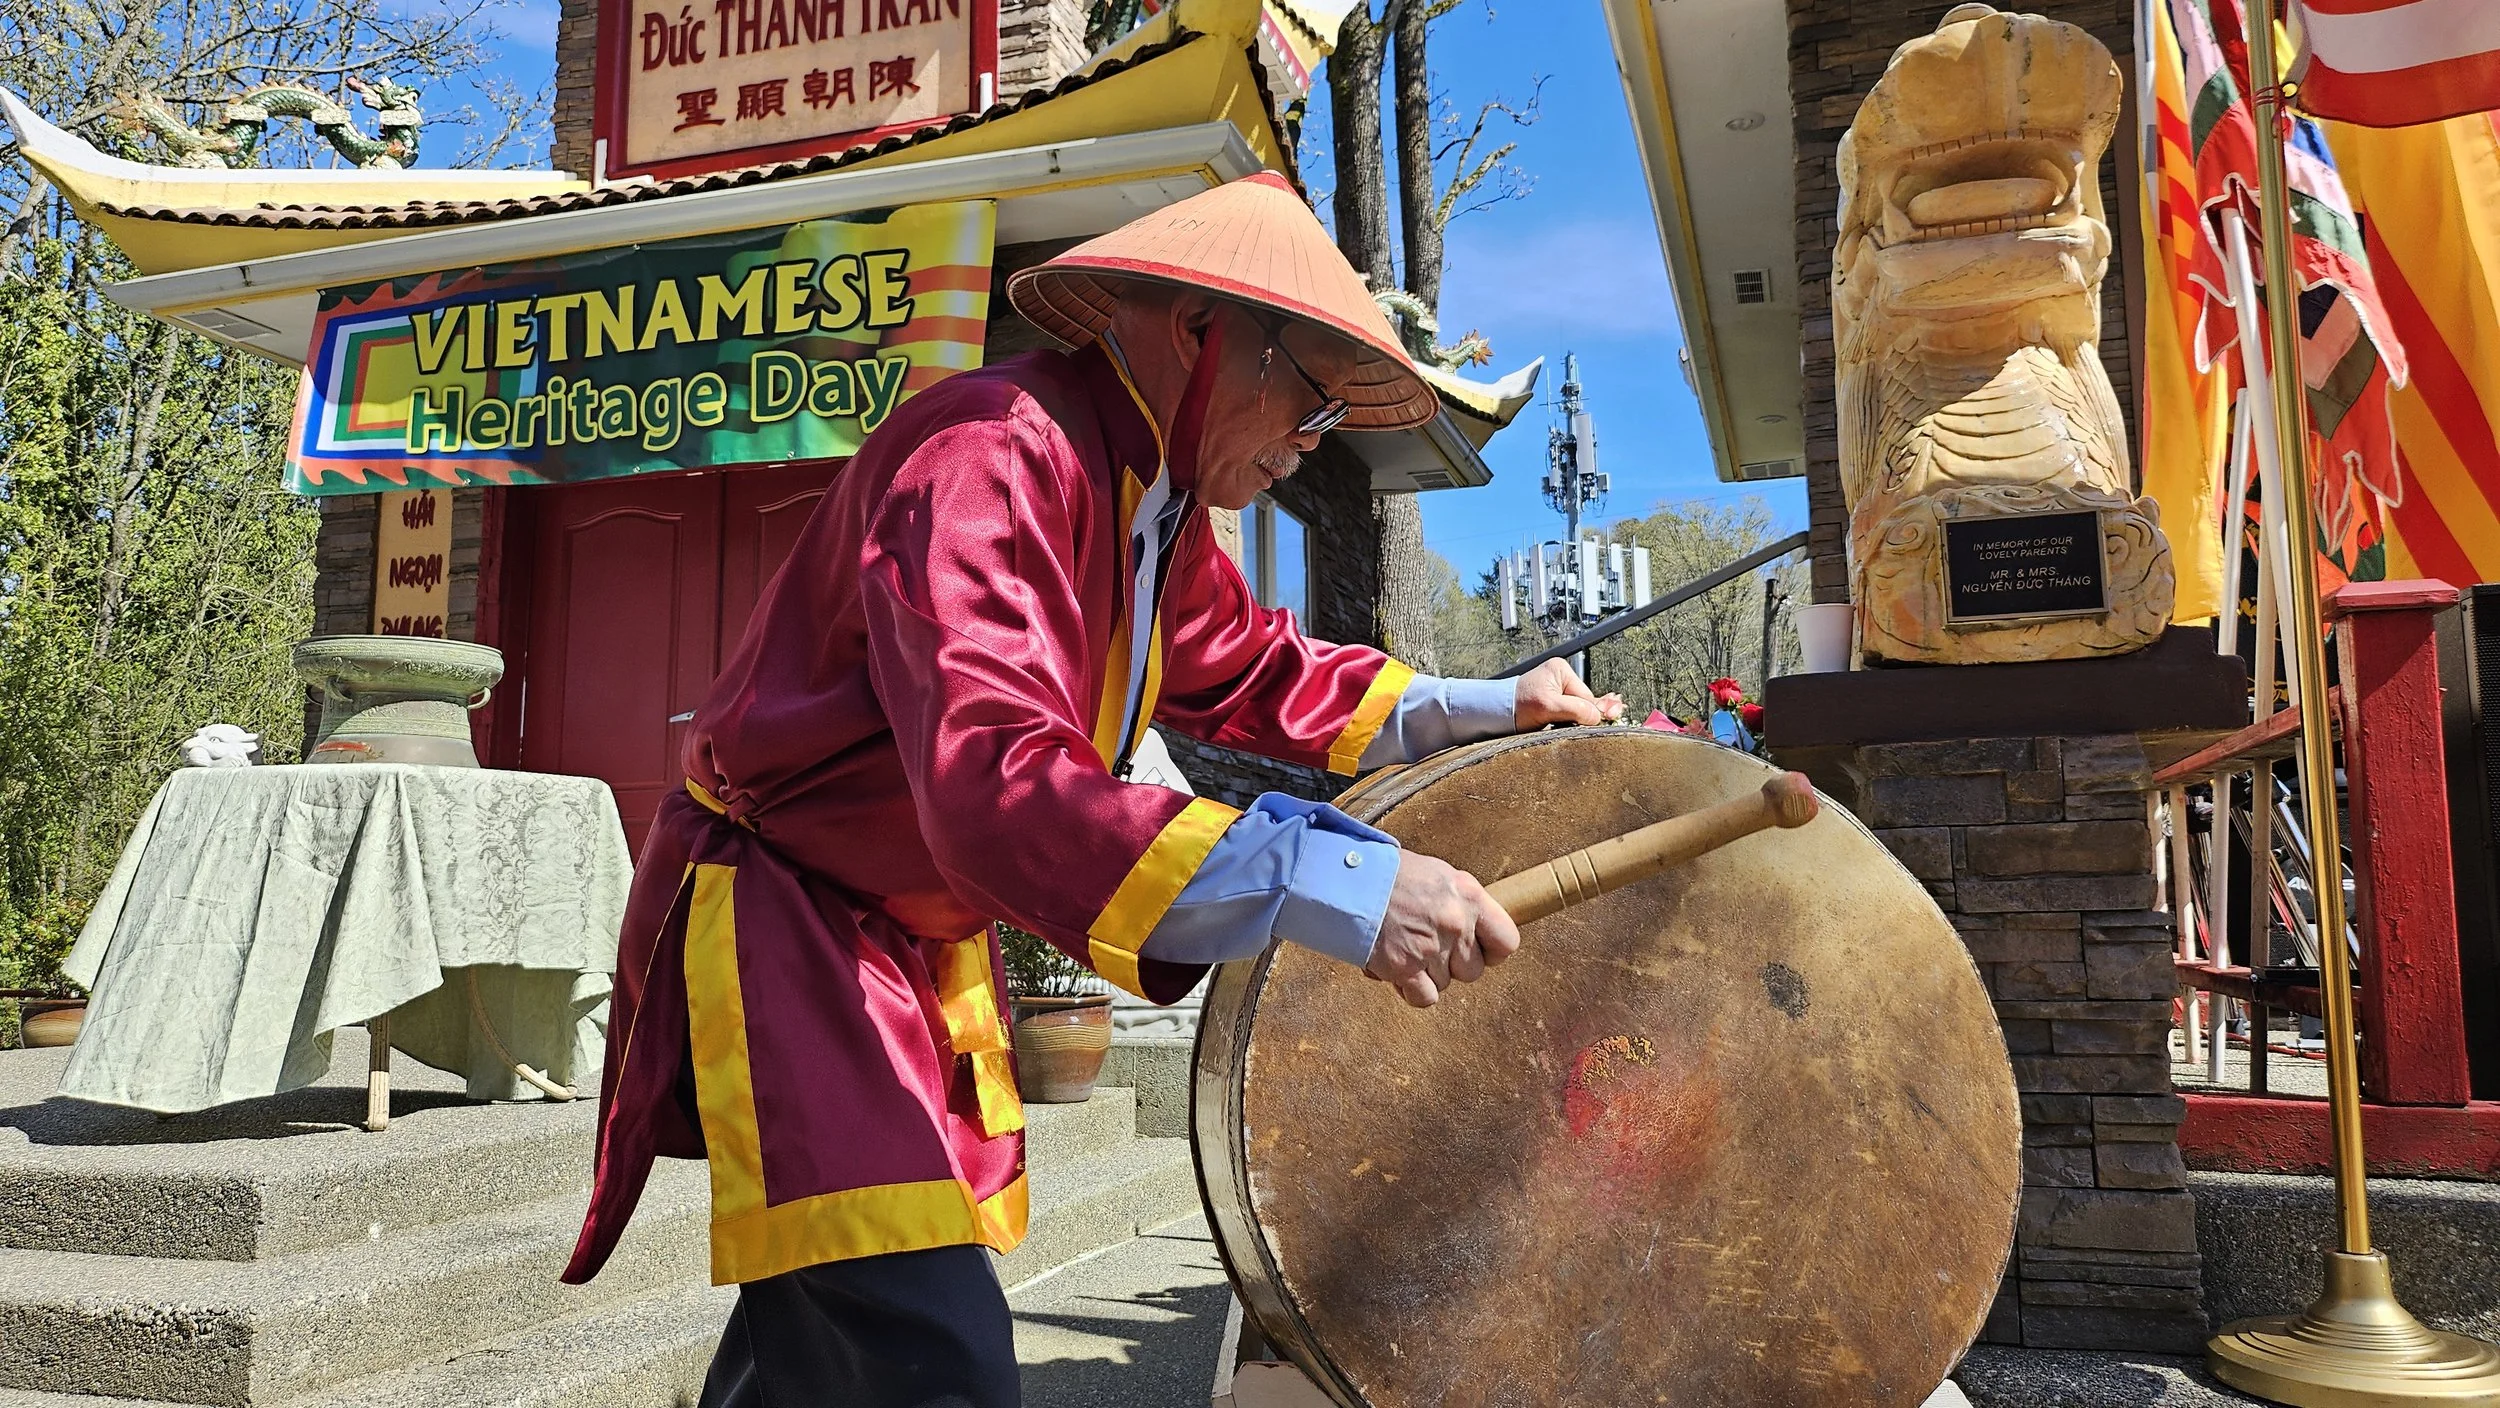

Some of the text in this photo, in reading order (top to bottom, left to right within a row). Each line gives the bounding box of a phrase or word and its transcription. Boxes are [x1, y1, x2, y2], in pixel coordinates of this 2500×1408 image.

[640, 5, 706, 72] Đức
[410, 250, 913, 374] VIETNAMESE
[404, 348, 910, 455] Heritage Day
[1973, 536, 2073, 552] IN MEMORY OF OUR
[1979, 546, 2068, 560] LOVELY PARENTS
[1990, 566, 2060, 580] MR. & MRS.
